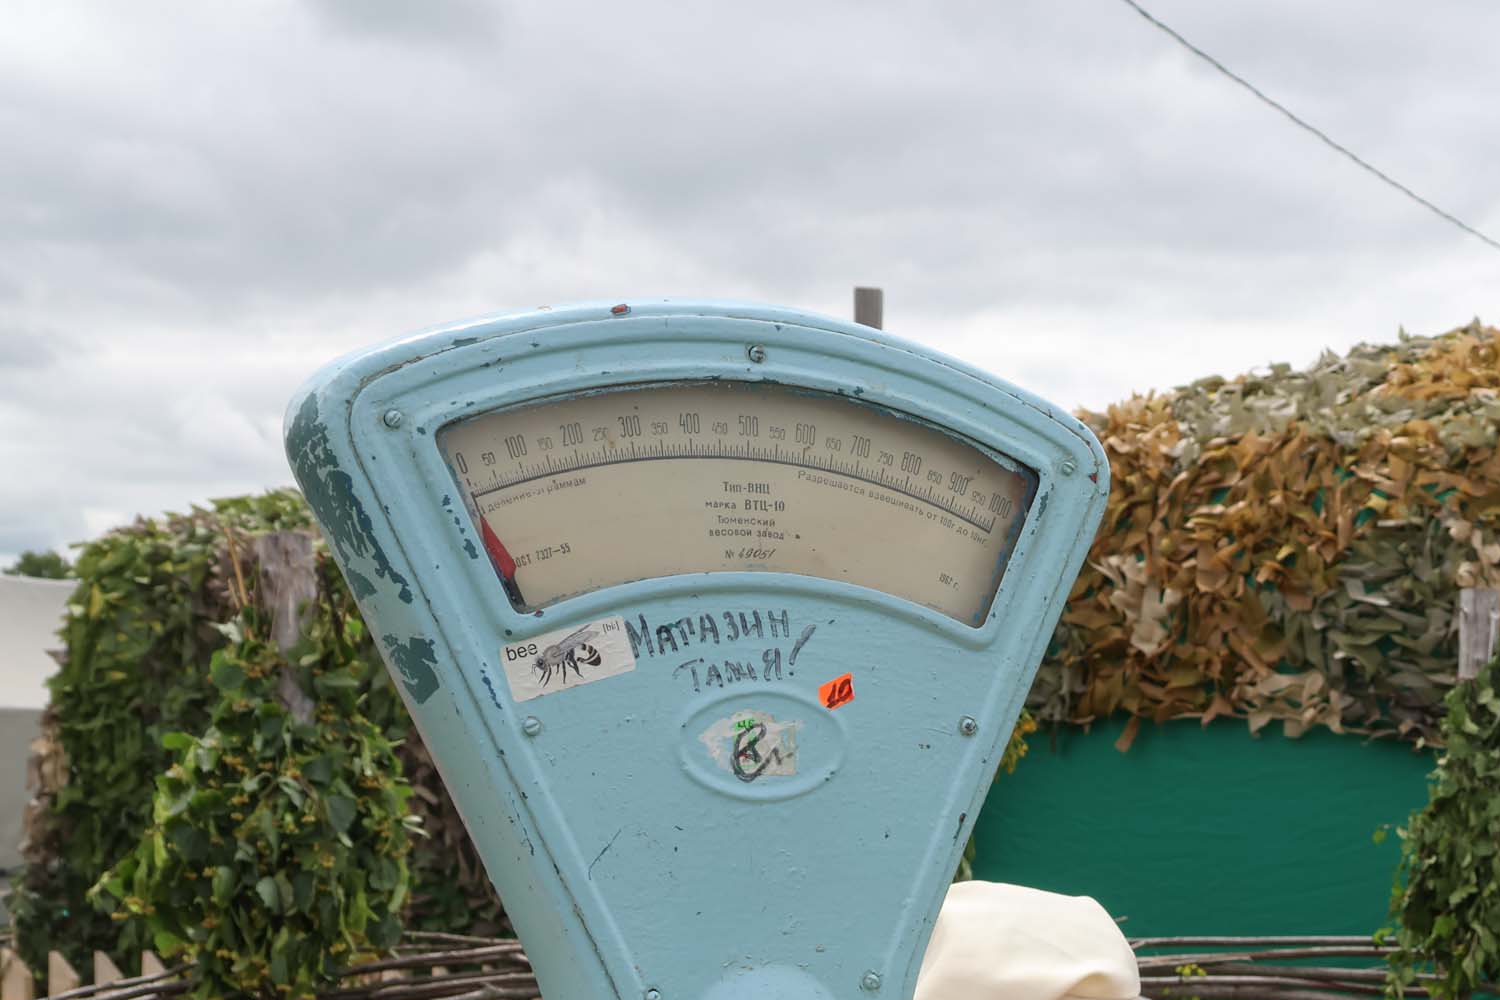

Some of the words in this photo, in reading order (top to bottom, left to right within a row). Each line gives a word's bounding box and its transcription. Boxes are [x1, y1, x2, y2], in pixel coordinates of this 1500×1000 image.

[455, 452, 469, 474] 0
[481, 452, 496, 467] 50
[504, 434, 528, 460] 100
[560, 422, 584, 447] 200
[617, 415, 642, 438] 300
[650, 422, 668, 435] 350
[679, 413, 700, 434] 400
[711, 422, 728, 435] 450
[738, 416, 759, 437] 500
[769, 425, 786, 440] 550
[795, 422, 816, 446] 600
[825, 437, 841, 451] 650
[850, 435, 871, 459] 700
[876, 451, 894, 466] 750
[901, 452, 922, 475] 800
[927, 469, 943, 485] 850
[949, 471, 969, 496] 900
[987, 492, 1013, 519] 1000
[705, 501, 737, 509] марка
[744, 499, 785, 512] ВТЦ-10
[505, 643, 539, 662] bee
